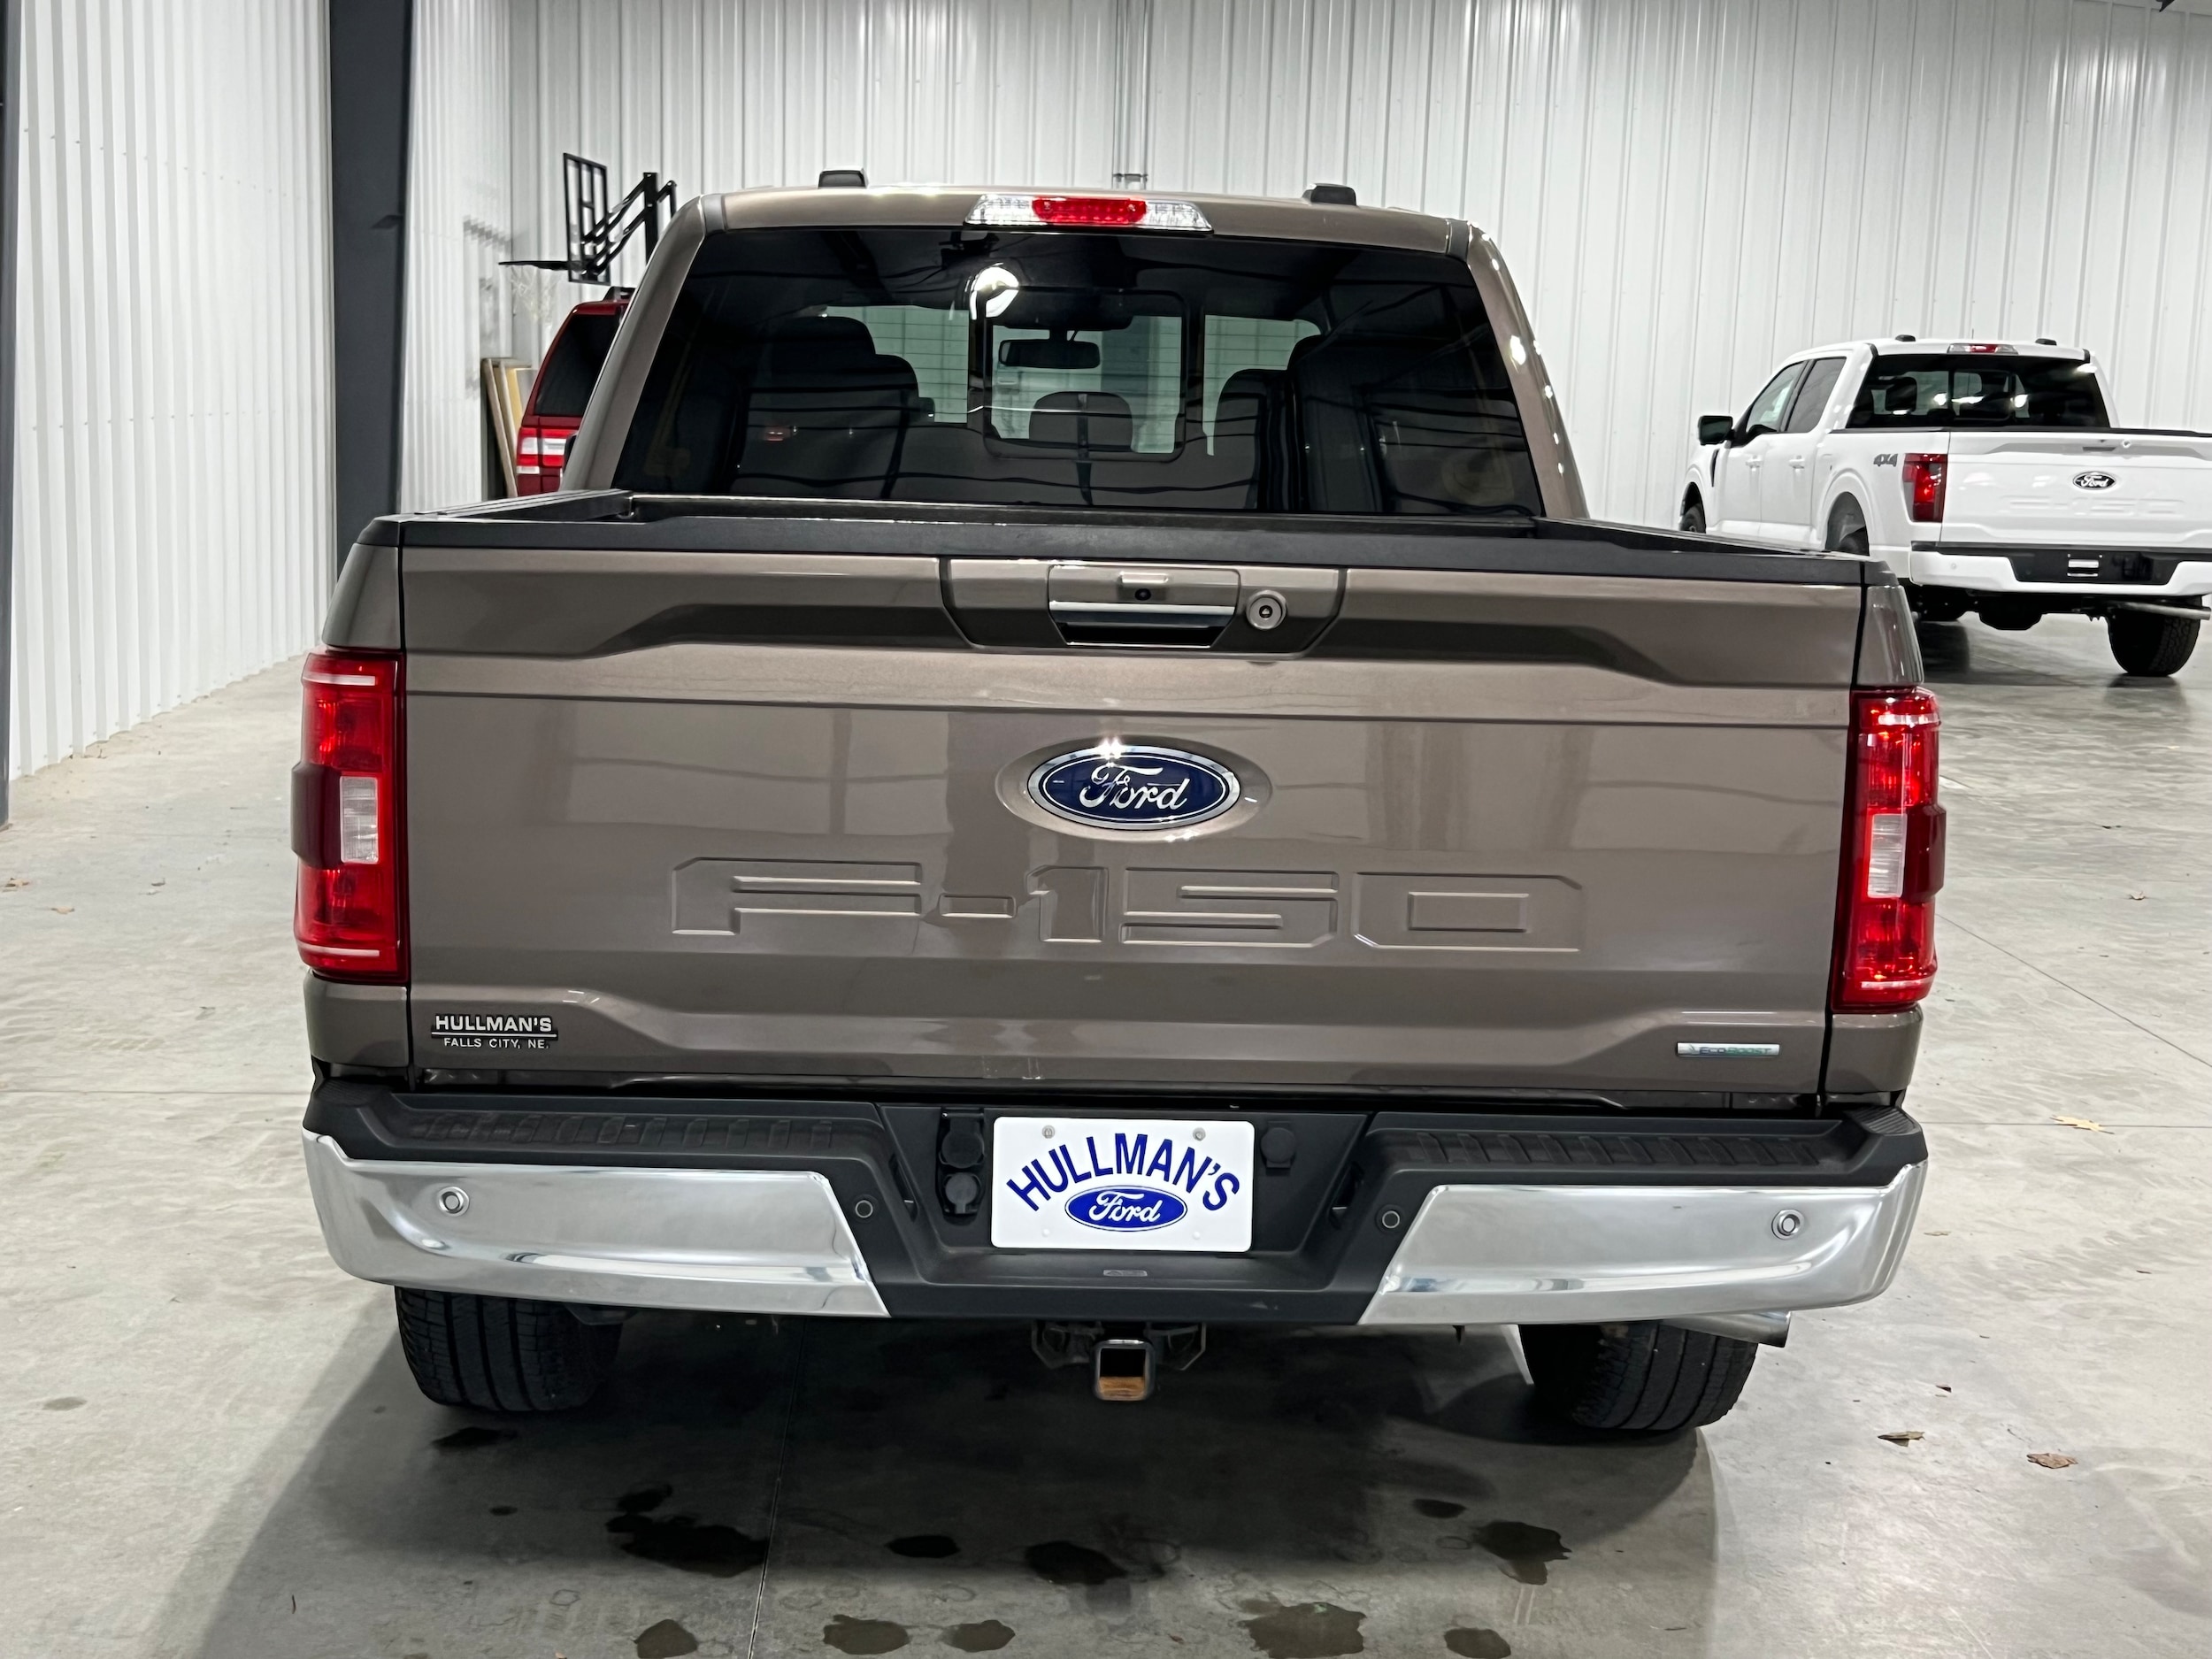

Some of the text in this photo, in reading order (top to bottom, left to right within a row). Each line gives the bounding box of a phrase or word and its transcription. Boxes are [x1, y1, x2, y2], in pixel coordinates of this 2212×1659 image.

[1079, 762, 1191, 810] Ford
[672, 856, 1586, 953] F-150
[435, 1015, 552, 1033] HULLMAN'S
[443, 1037, 482, 1048] FALLS
[1006, 1133, 1240, 1212] HULLMAN'S
[1088, 1190, 1163, 1223] Ford
